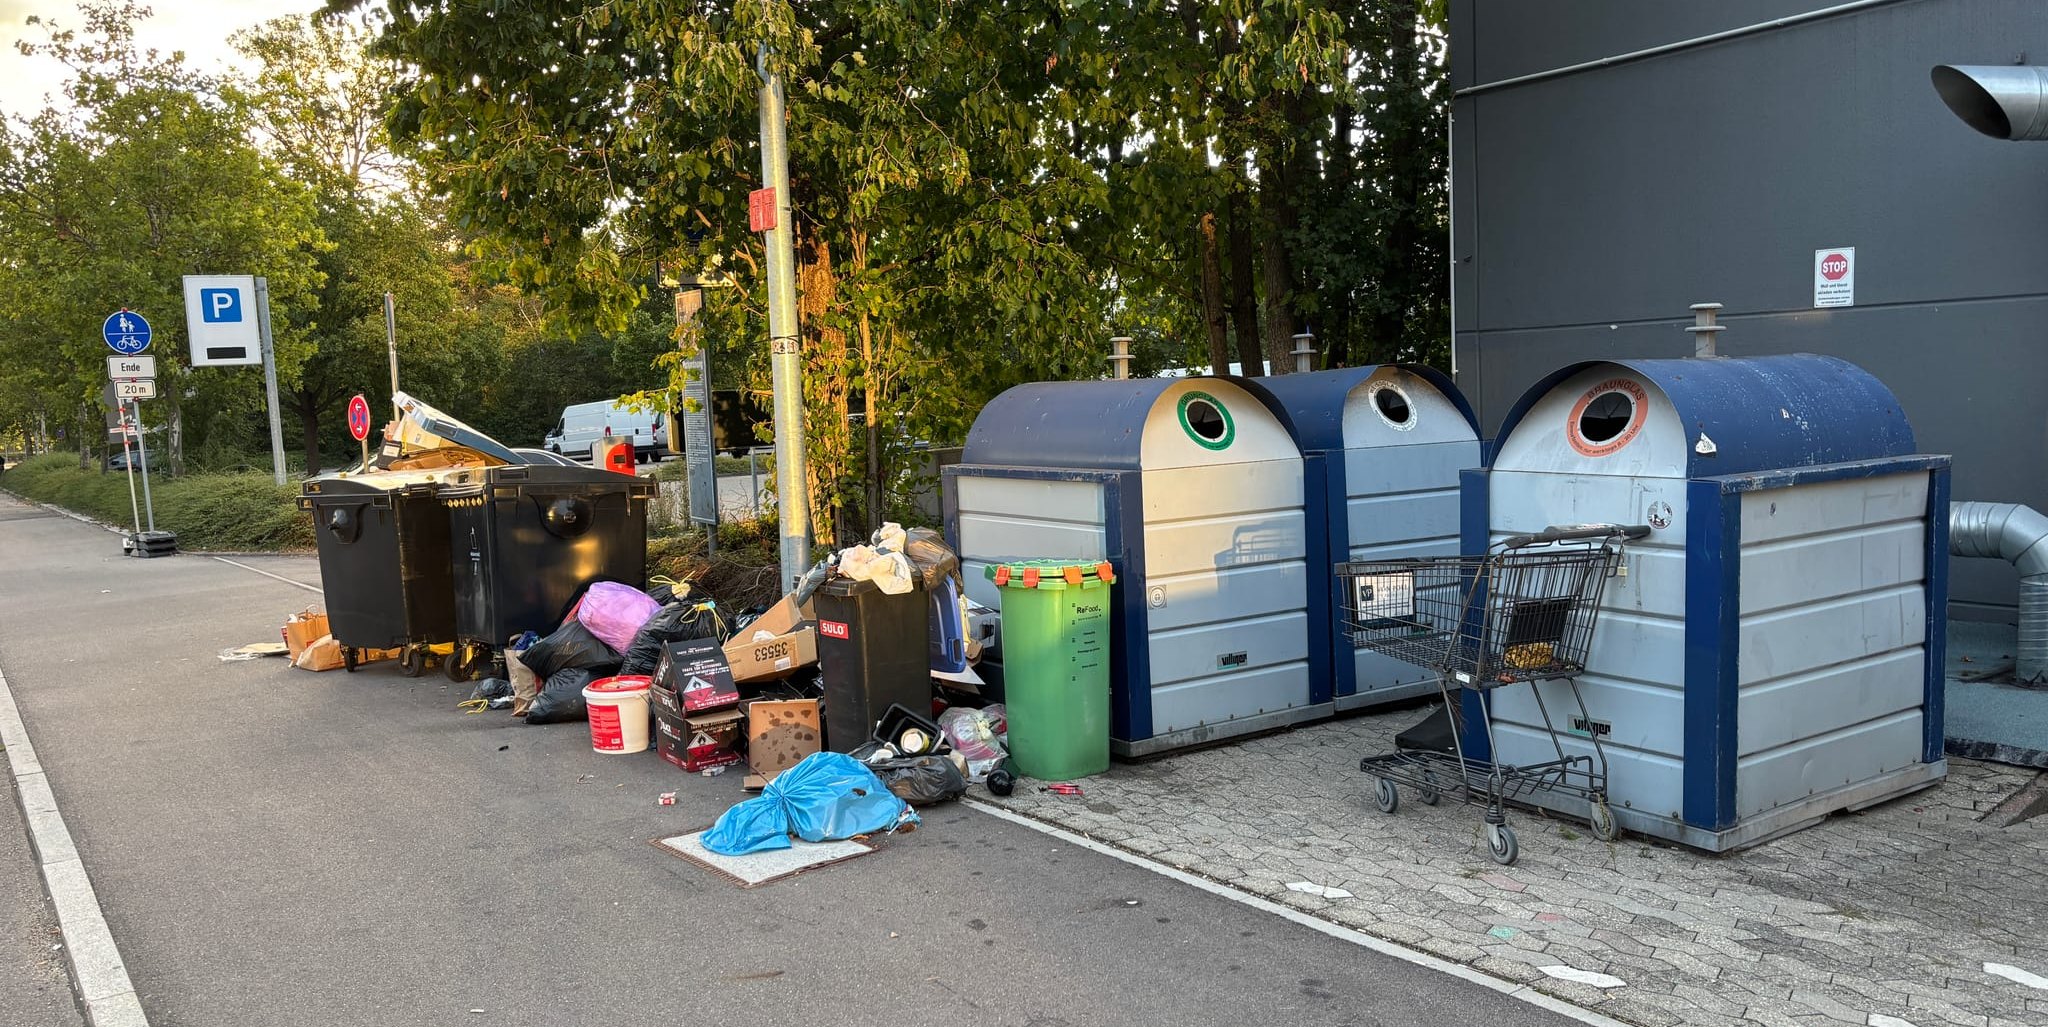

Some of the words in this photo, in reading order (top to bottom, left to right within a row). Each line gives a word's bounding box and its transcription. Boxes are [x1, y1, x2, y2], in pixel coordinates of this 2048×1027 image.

[1822, 260, 1847, 273] STOP
[212, 292, 233, 319] P
[121, 362, 141, 372] Ende
[124, 385, 137, 394] 20
[1587, 379, 1645, 401] BRAUNGLAS
[822, 622, 844, 635] SULO
[754, 641, 788, 662] 35553
